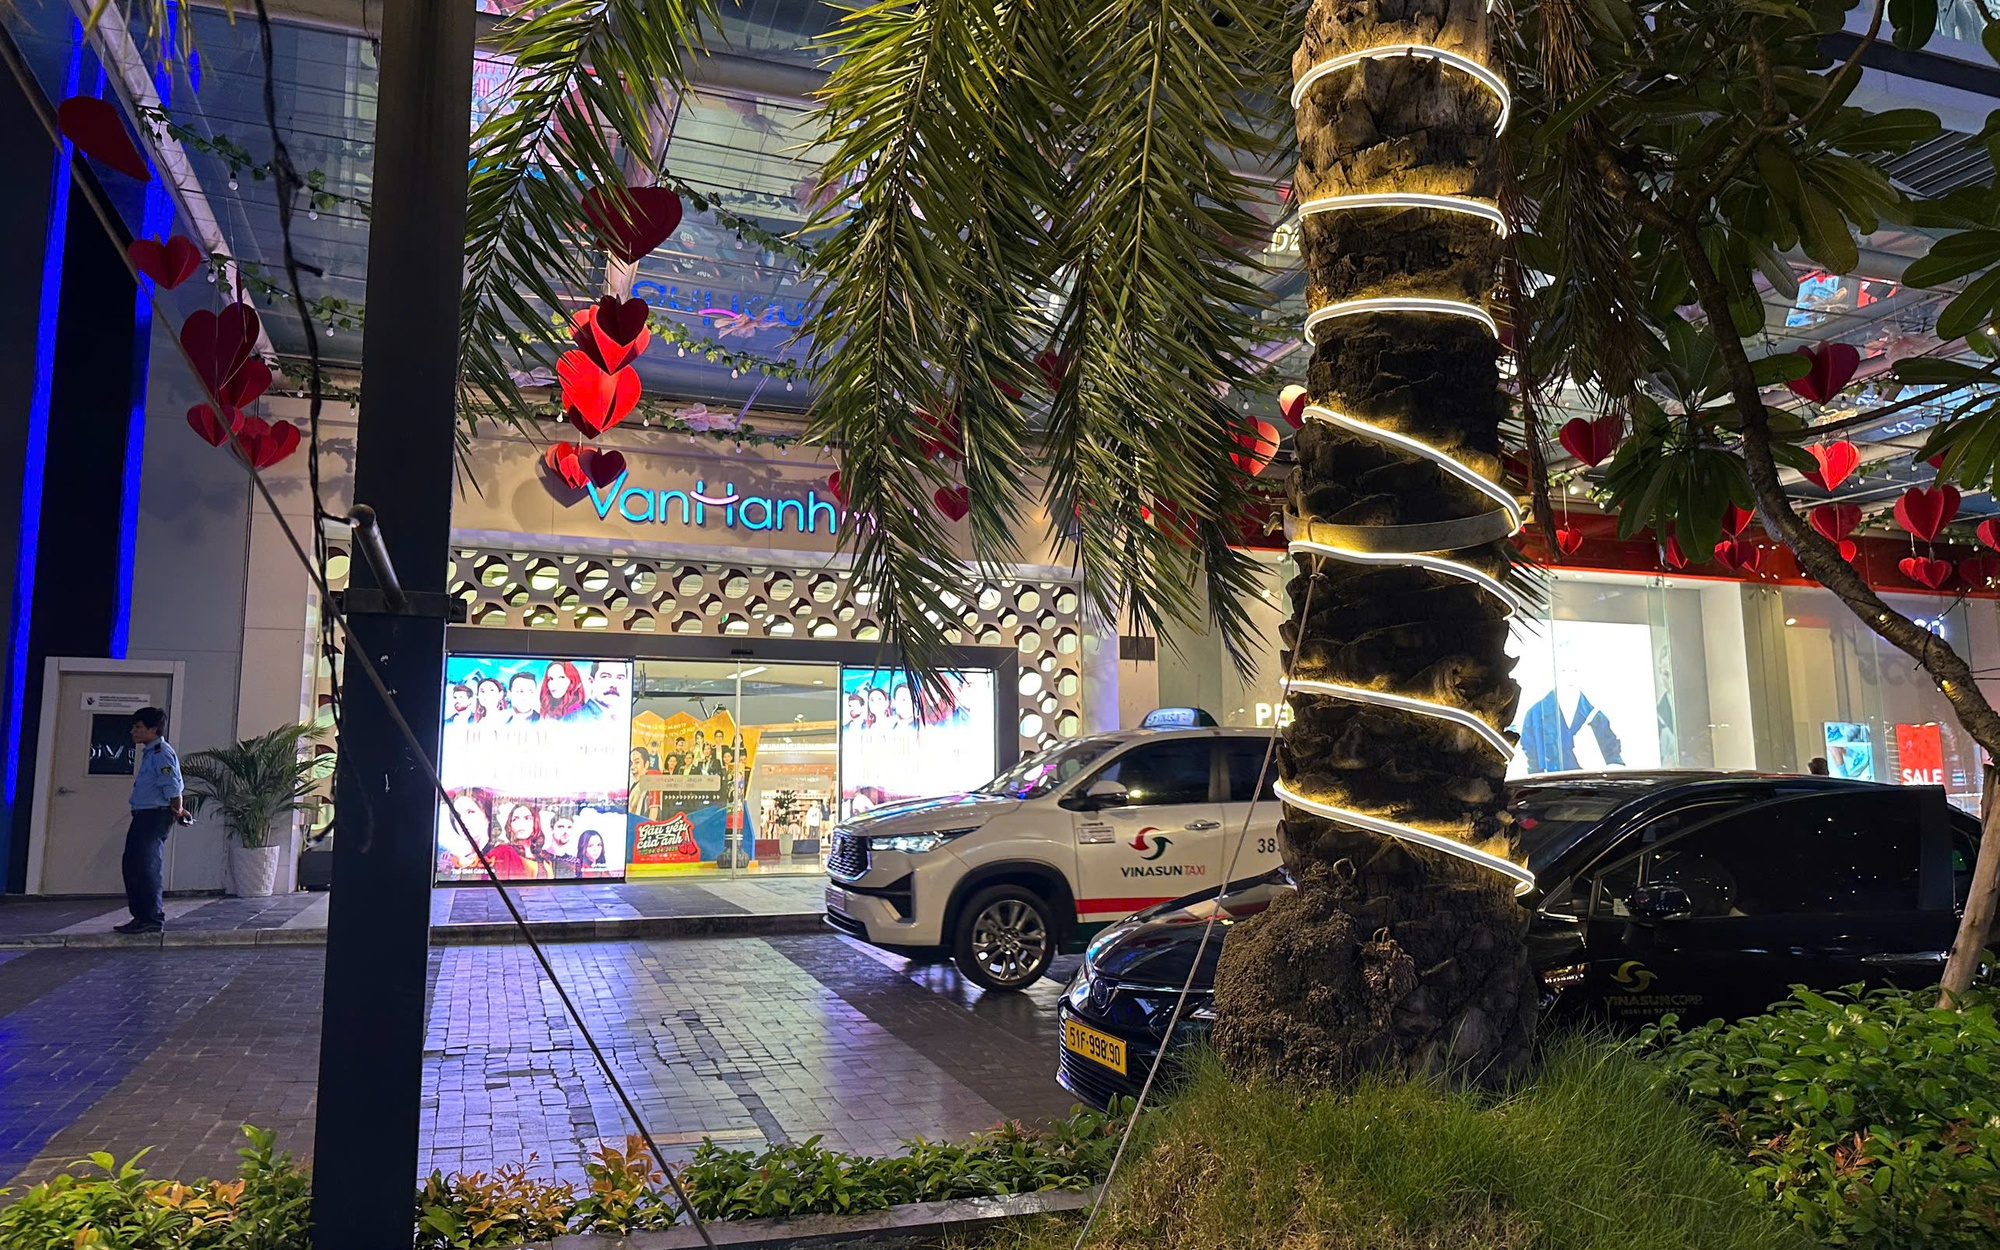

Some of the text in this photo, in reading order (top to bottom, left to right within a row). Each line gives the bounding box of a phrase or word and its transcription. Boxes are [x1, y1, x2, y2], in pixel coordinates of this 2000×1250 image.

[586, 468, 837, 535] VanHanh
[1902, 768, 1943, 785] SALE
[661, 832, 683, 846] anh
[1257, 838, 1279, 853] 38
[1121, 865, 1205, 877] VINASUN TAXI
